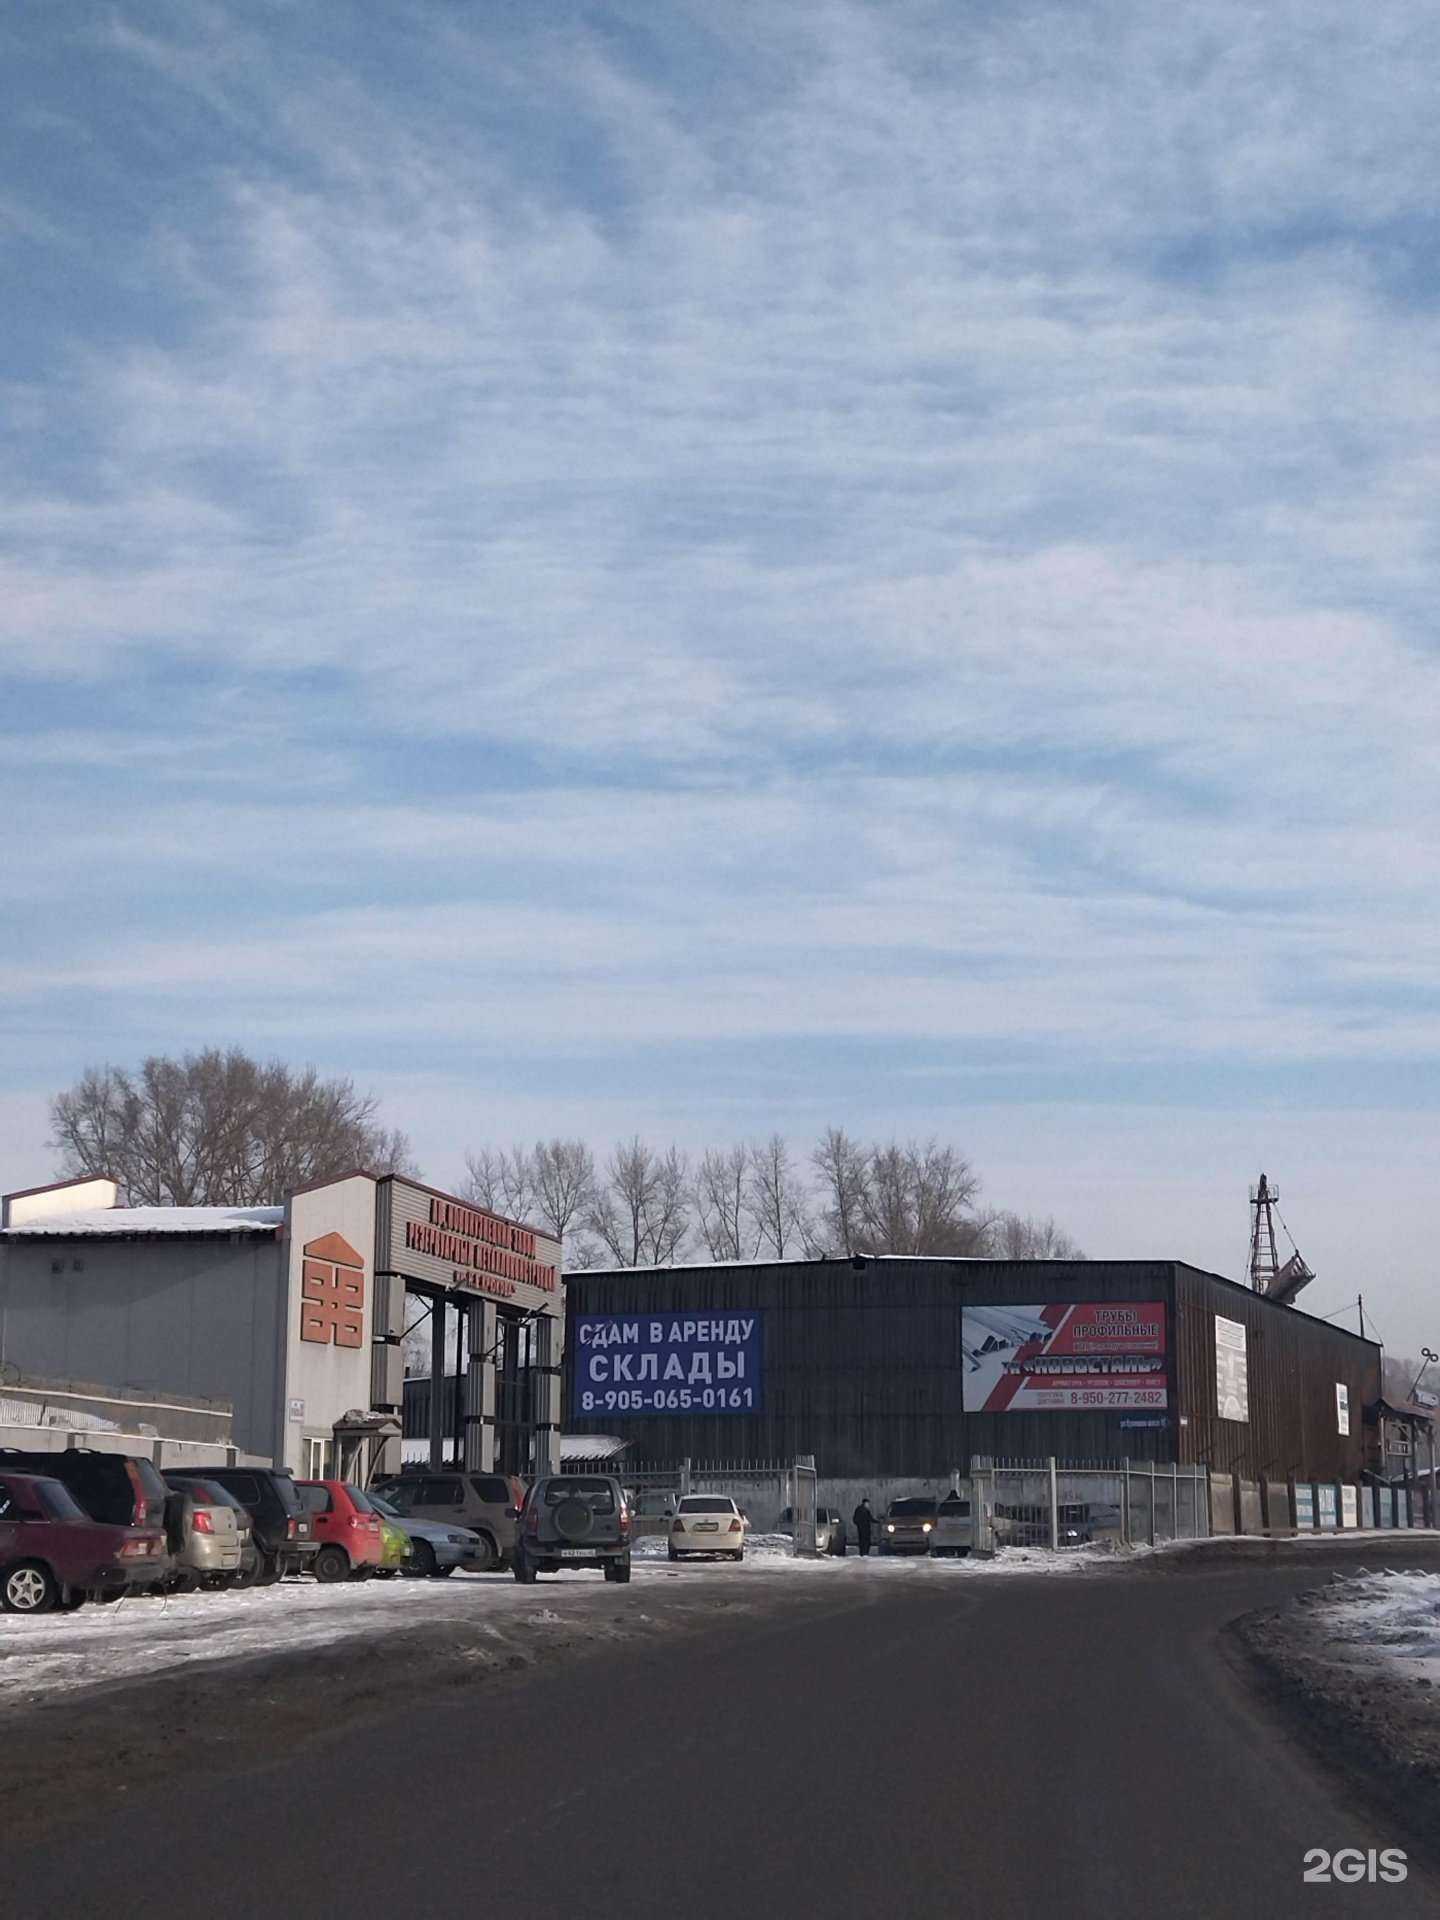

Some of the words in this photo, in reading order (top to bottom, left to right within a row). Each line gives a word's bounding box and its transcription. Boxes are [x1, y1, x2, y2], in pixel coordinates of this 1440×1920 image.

[1096, 1310, 1138, 1323] ТРУБЫ
[580, 1323, 639, 1348] СДАМ
[650, 1322, 663, 1343] В
[668, 1319, 754, 1344] АРЕНДУ
[1073, 1324, 1160, 1338] ПРОФИЛЬНЫЕ
[589, 1351, 745, 1384] СКЛАДЫ
[582, 1387, 753, 1411] 8-905-065-0161
[1070, 1391, 1162, 1405] 8-950-277-2482
